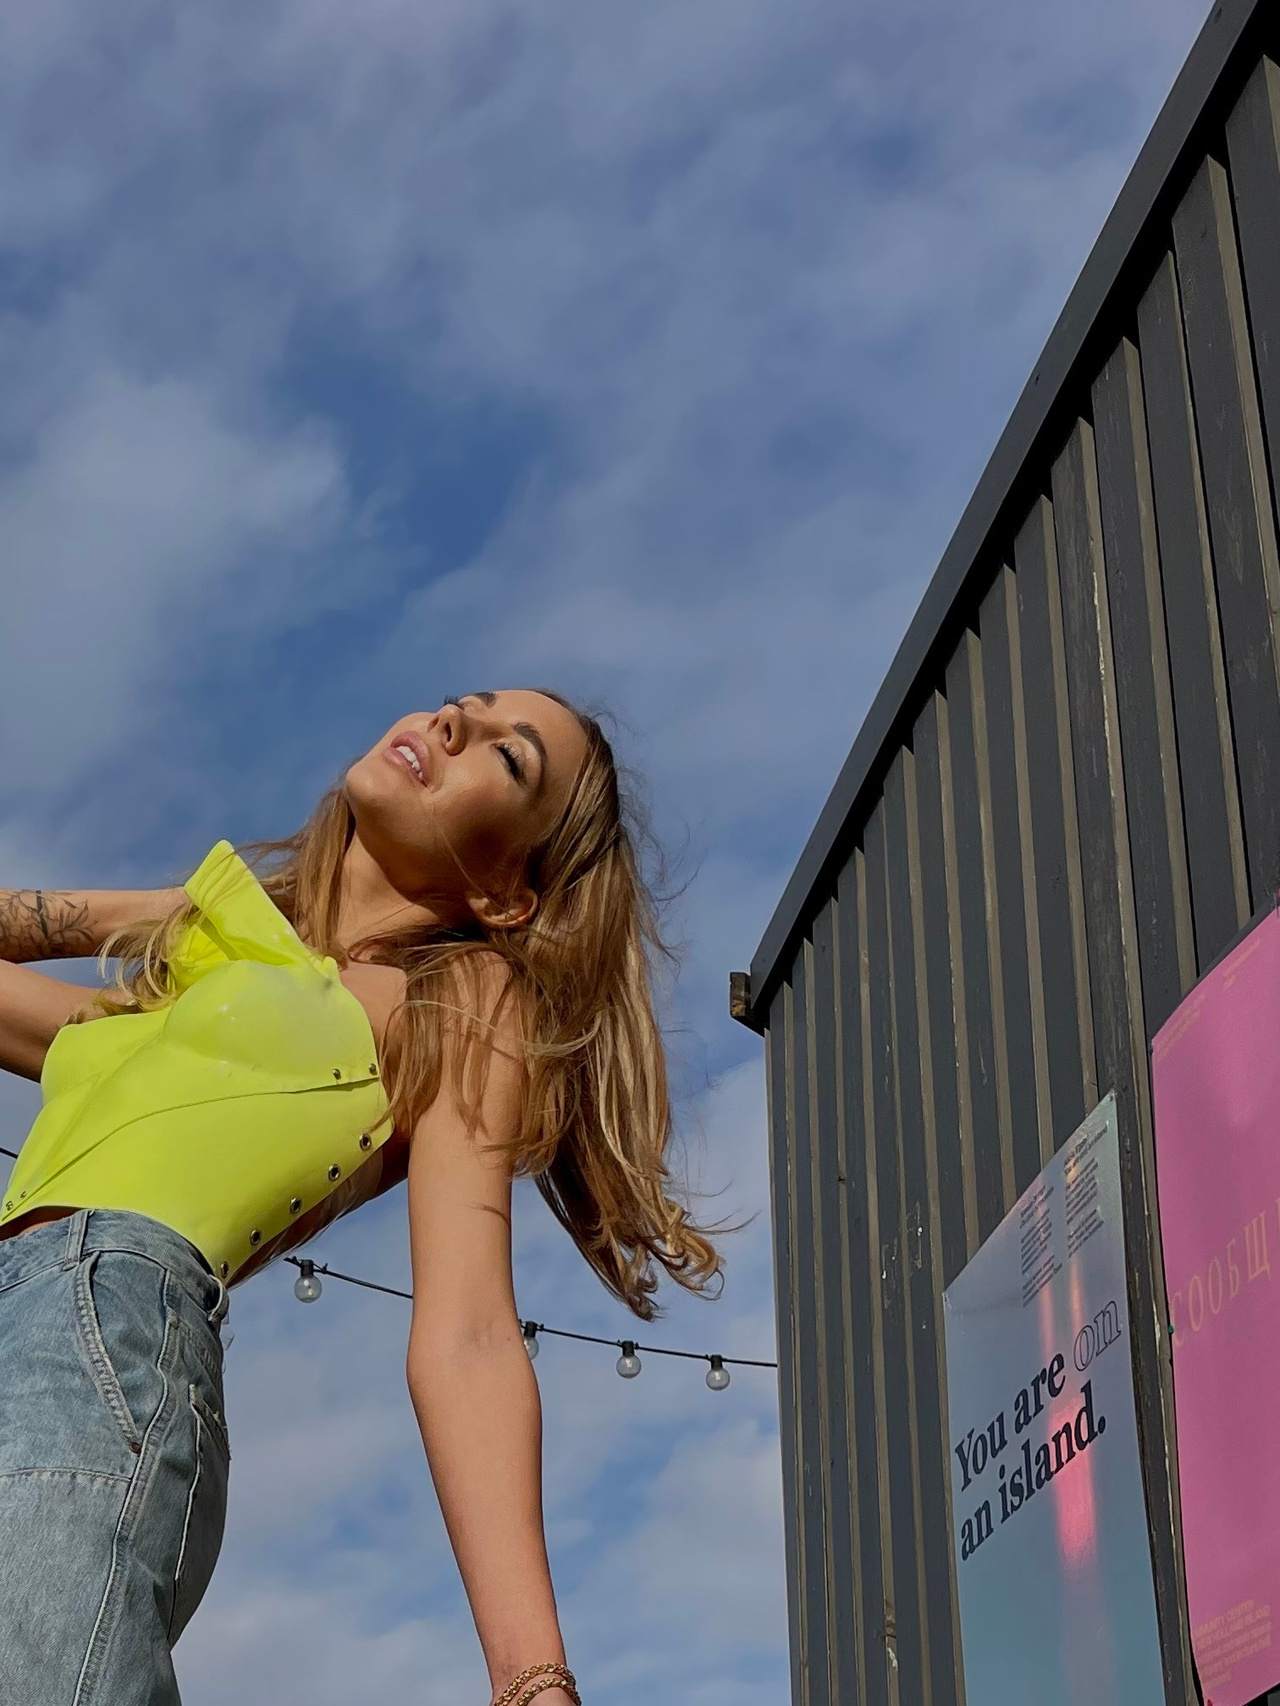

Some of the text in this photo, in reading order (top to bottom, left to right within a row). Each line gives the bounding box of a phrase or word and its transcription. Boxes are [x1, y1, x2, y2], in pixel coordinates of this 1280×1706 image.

[1169, 1197, 1280, 1348] СООБЩ
[954, 1299, 1122, 1492] You are on
[960, 1494, 995, 1562] an
[998, 1380, 1107, 1525] island.
